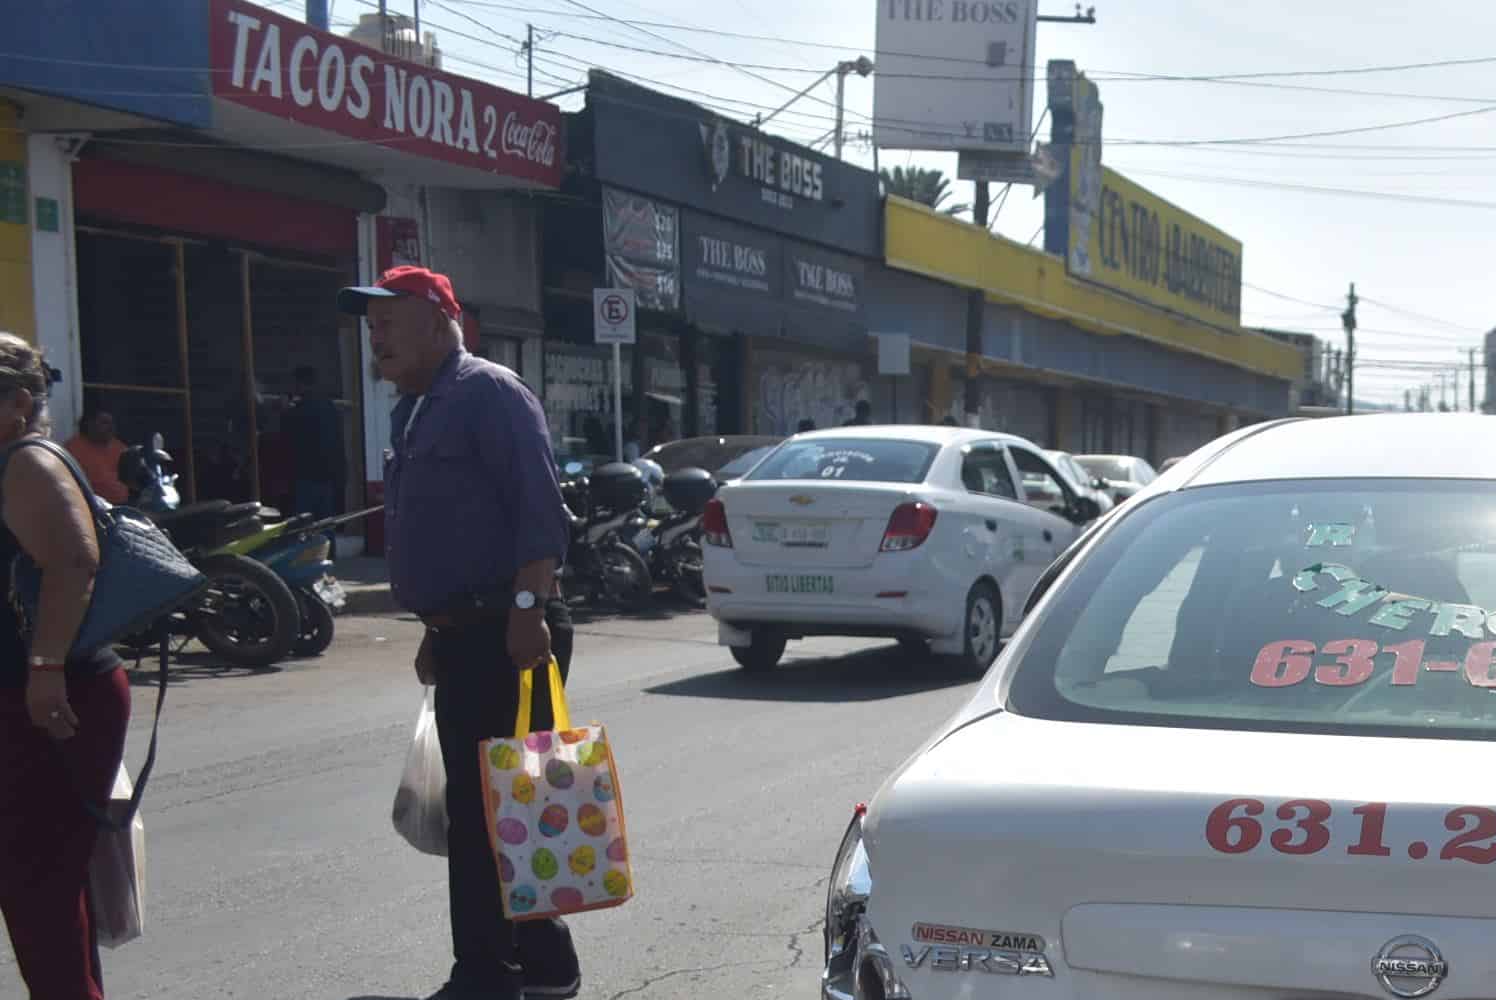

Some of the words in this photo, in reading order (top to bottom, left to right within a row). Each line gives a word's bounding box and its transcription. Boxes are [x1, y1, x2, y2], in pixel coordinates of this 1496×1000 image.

[885, 0, 943, 21] THE
[951, 0, 1018, 23] BOSS
[228, 10, 375, 120] TACOS
[383, 63, 482, 154] NORA
[484, 104, 498, 158] 2
[741, 136, 775, 184] THE
[780, 152, 824, 201] BOSS
[701, 238, 732, 269] THE
[733, 246, 767, 277] BOSS
[798, 260, 824, 290] THE
[825, 268, 855, 299] BOSS
[916, 926, 985, 945] NISSAN
[991, 934, 1038, 951] ZAMA
[900, 943, 1056, 979] VERSA
[1378, 960, 1443, 977] NISSAN
